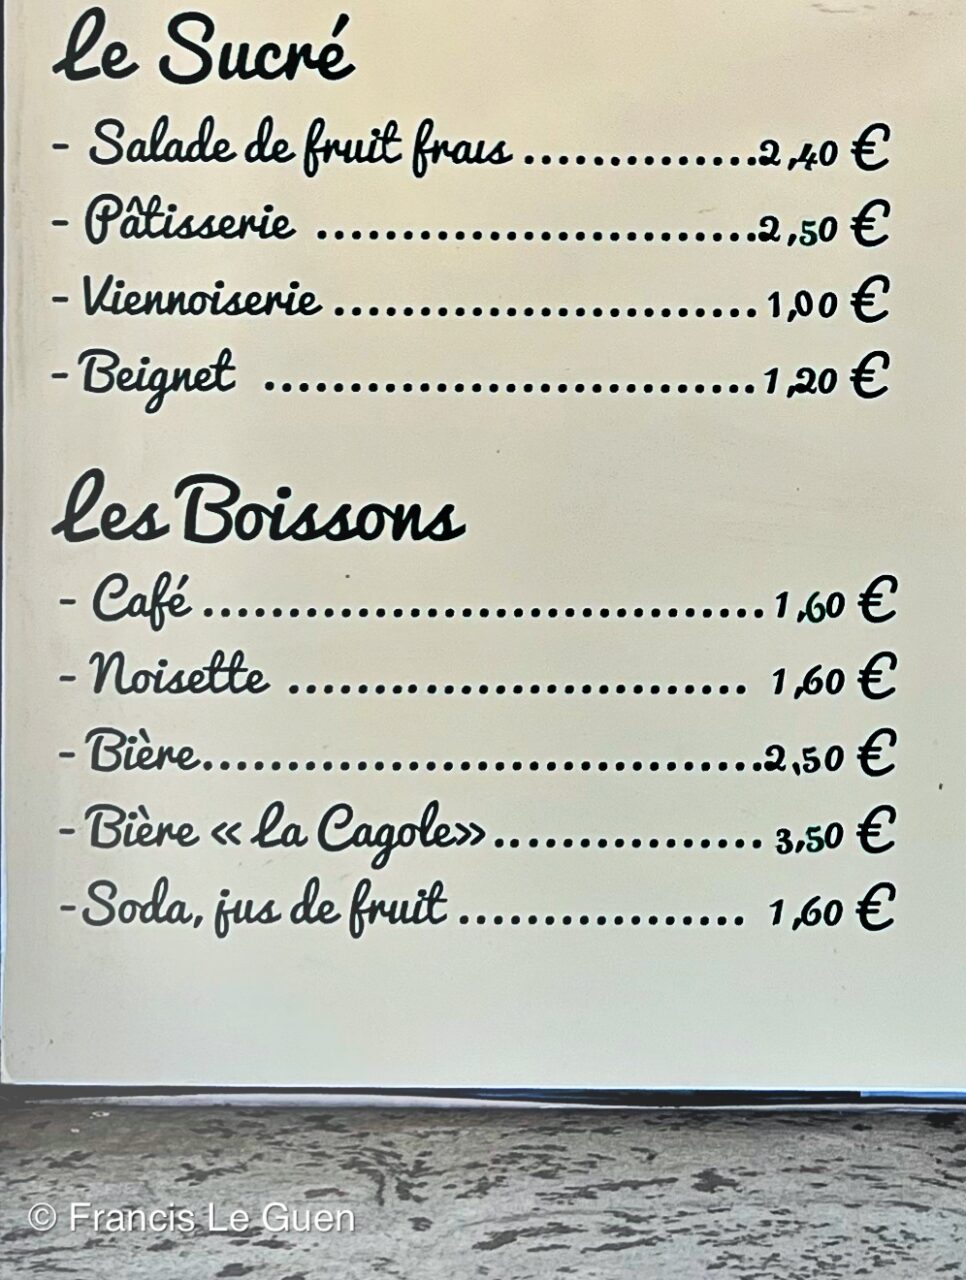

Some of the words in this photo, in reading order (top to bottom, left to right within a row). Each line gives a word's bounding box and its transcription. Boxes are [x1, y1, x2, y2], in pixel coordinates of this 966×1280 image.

[158, 11, 357, 85] Sucré
[89, 114, 238, 166] Salade
[244, 115, 297, 164] de
[303, 116, 403, 178] fruit
[412, 117, 514, 179] frais
[758, 139, 839, 172] 2,40
[84, 193, 297, 245] Pâtisserie
[757, 215, 838, 247] 2,50
[83, 274, 324, 316] Viennoiserie
[767, 289, 838, 323] 1,00
[77, 347, 237, 415] Beignet
[763, 366, 838, 399] 1,20
[174, 473, 467, 544] Boissons
[92, 570, 193, 632] Café
[775, 590, 846, 624] 1,60
[88, 649, 271, 695] Noisette
[772, 664, 846, 700] 1,60
[84, 726, 201, 773] Bière
[763, 744, 845, 777] 2,50
[84, 803, 201, 849] Bière
[317, 799, 486, 871] Cagole»
[775, 821, 844, 855] 3,50
[82, 876, 204, 929] Soda,
[214, 888, 282, 939] jus
[289, 876, 342, 925] de
[349, 877, 448, 940] fruit
[769, 895, 844, 932] 1,60
